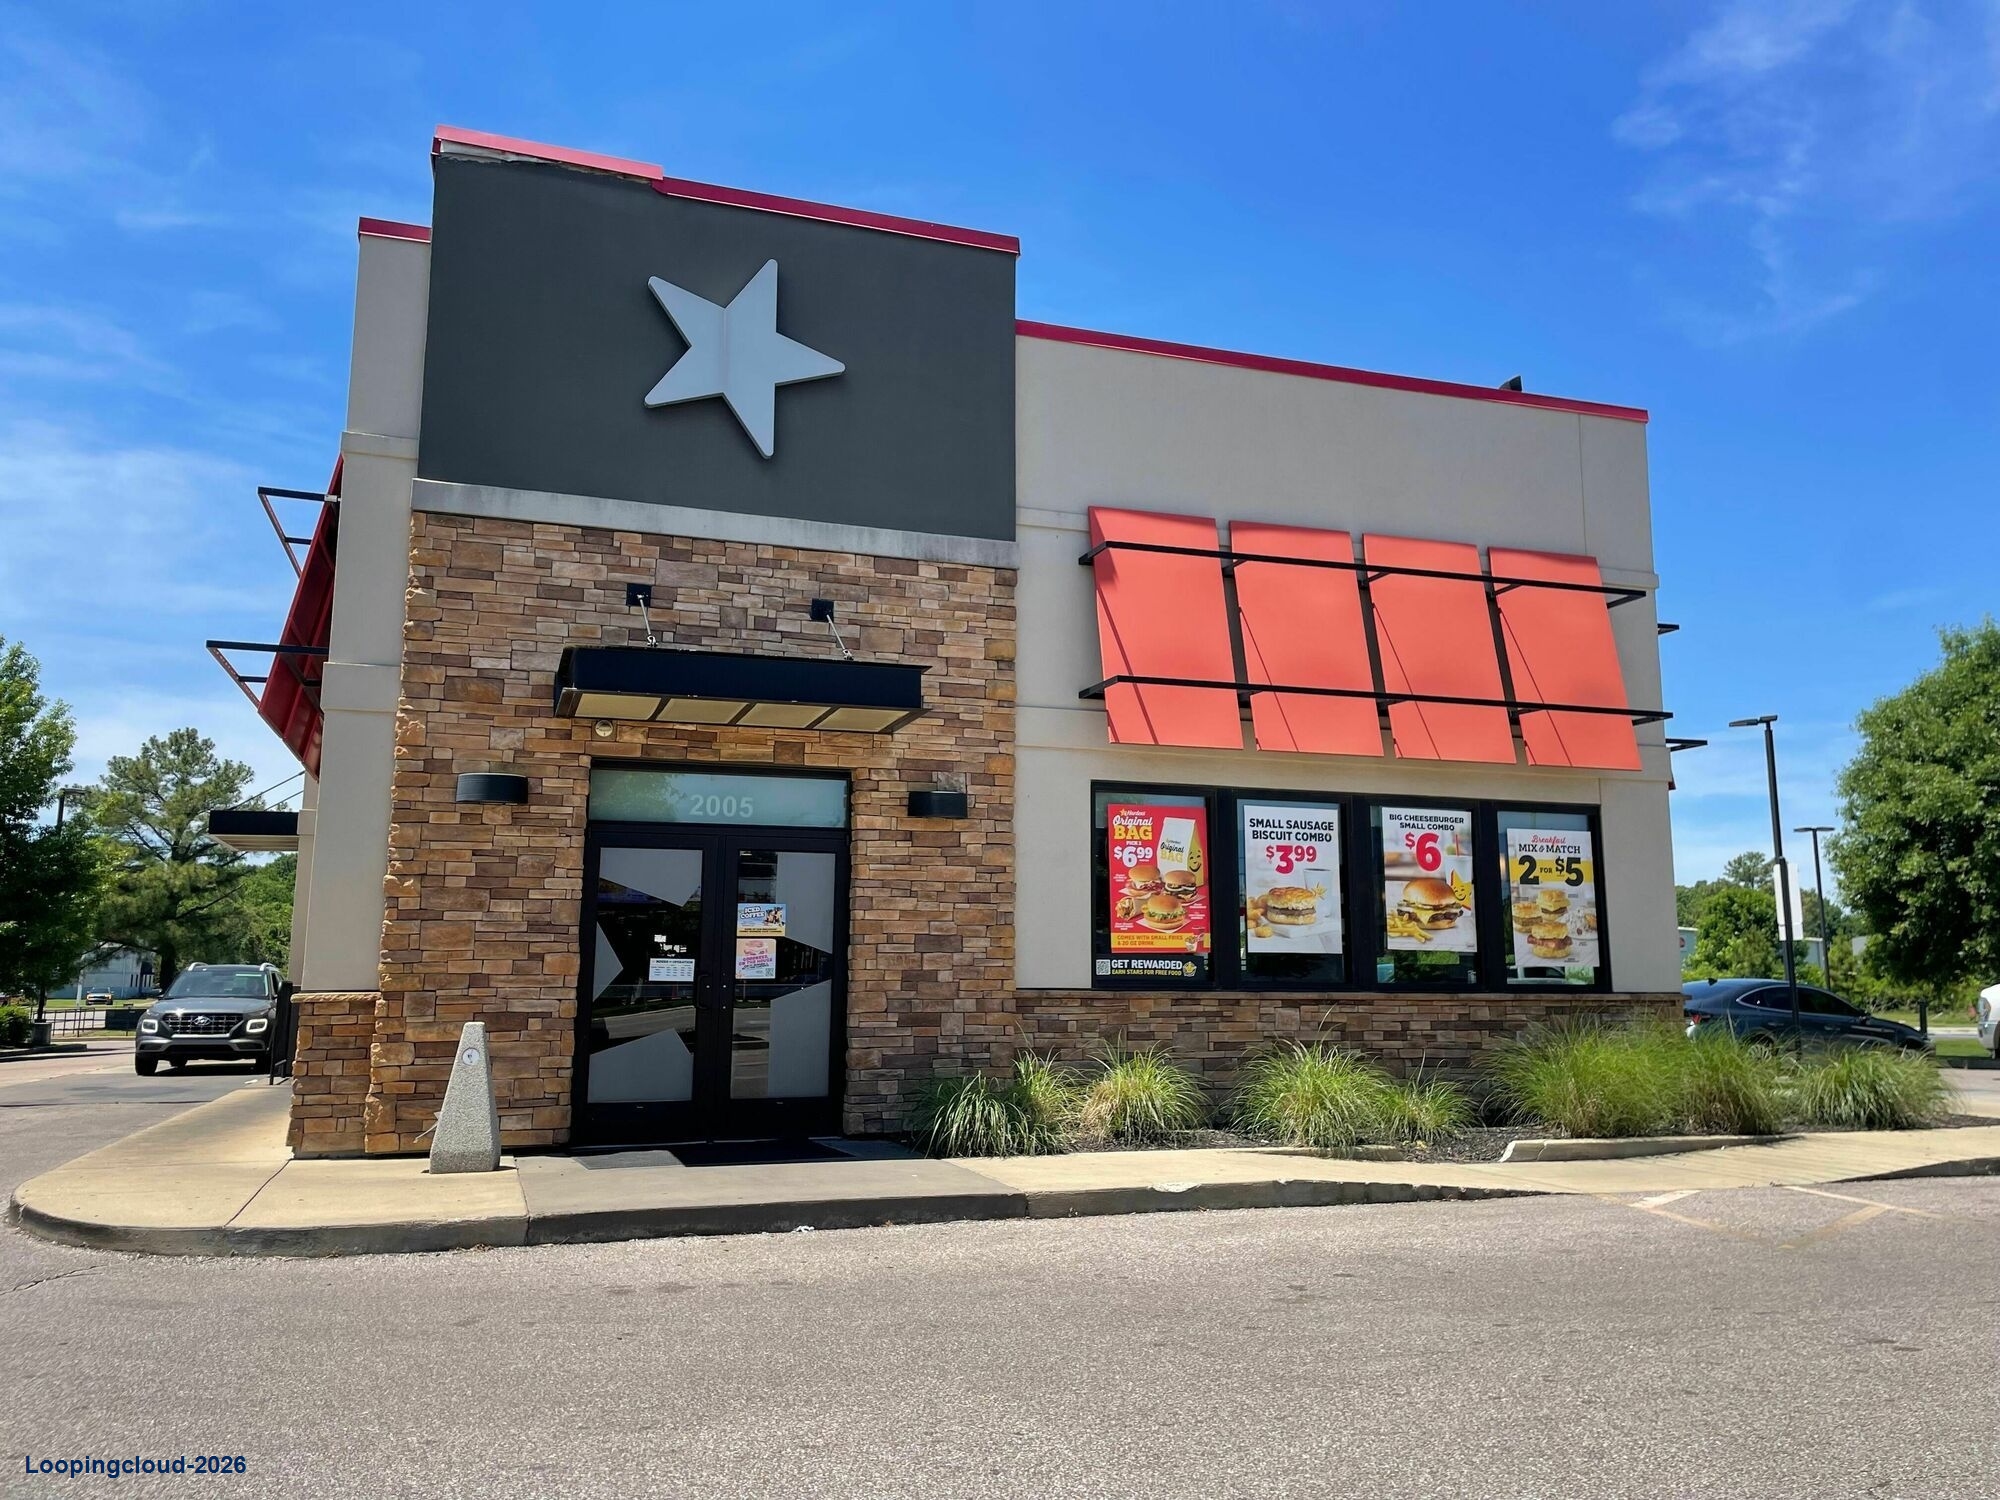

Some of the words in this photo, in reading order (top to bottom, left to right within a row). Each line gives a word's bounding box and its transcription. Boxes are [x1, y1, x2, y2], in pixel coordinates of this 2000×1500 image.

[689, 794, 753, 818] 2005
[1113, 815, 1153, 828] Original
[1249, 818, 1284, 829] SMALL
[1286, 820, 1334, 831] SAUSAGE
[1399, 822, 1426, 830] SMALL
[1404, 815, 1464, 824] CHEESEBURGER
[1114, 825, 1153, 840] BAG
[1252, 830, 1293, 841] BISCUIT
[1295, 832, 1332, 842] COMBO
[1531, 834, 1566, 846] Breakfast
[1160, 841, 1184, 854] Original
[1405, 832, 1442, 872] $6
[1518, 844, 1538, 852] MIX
[1538, 845, 1545, 853] &
[1546, 845, 1581, 854] MATCH
[1518, 855, 1540, 885] 2
[1555, 856, 1584, 887] $5
[1111, 959, 1129, 969] GET
[1131, 960, 1183, 970] REWARDED
